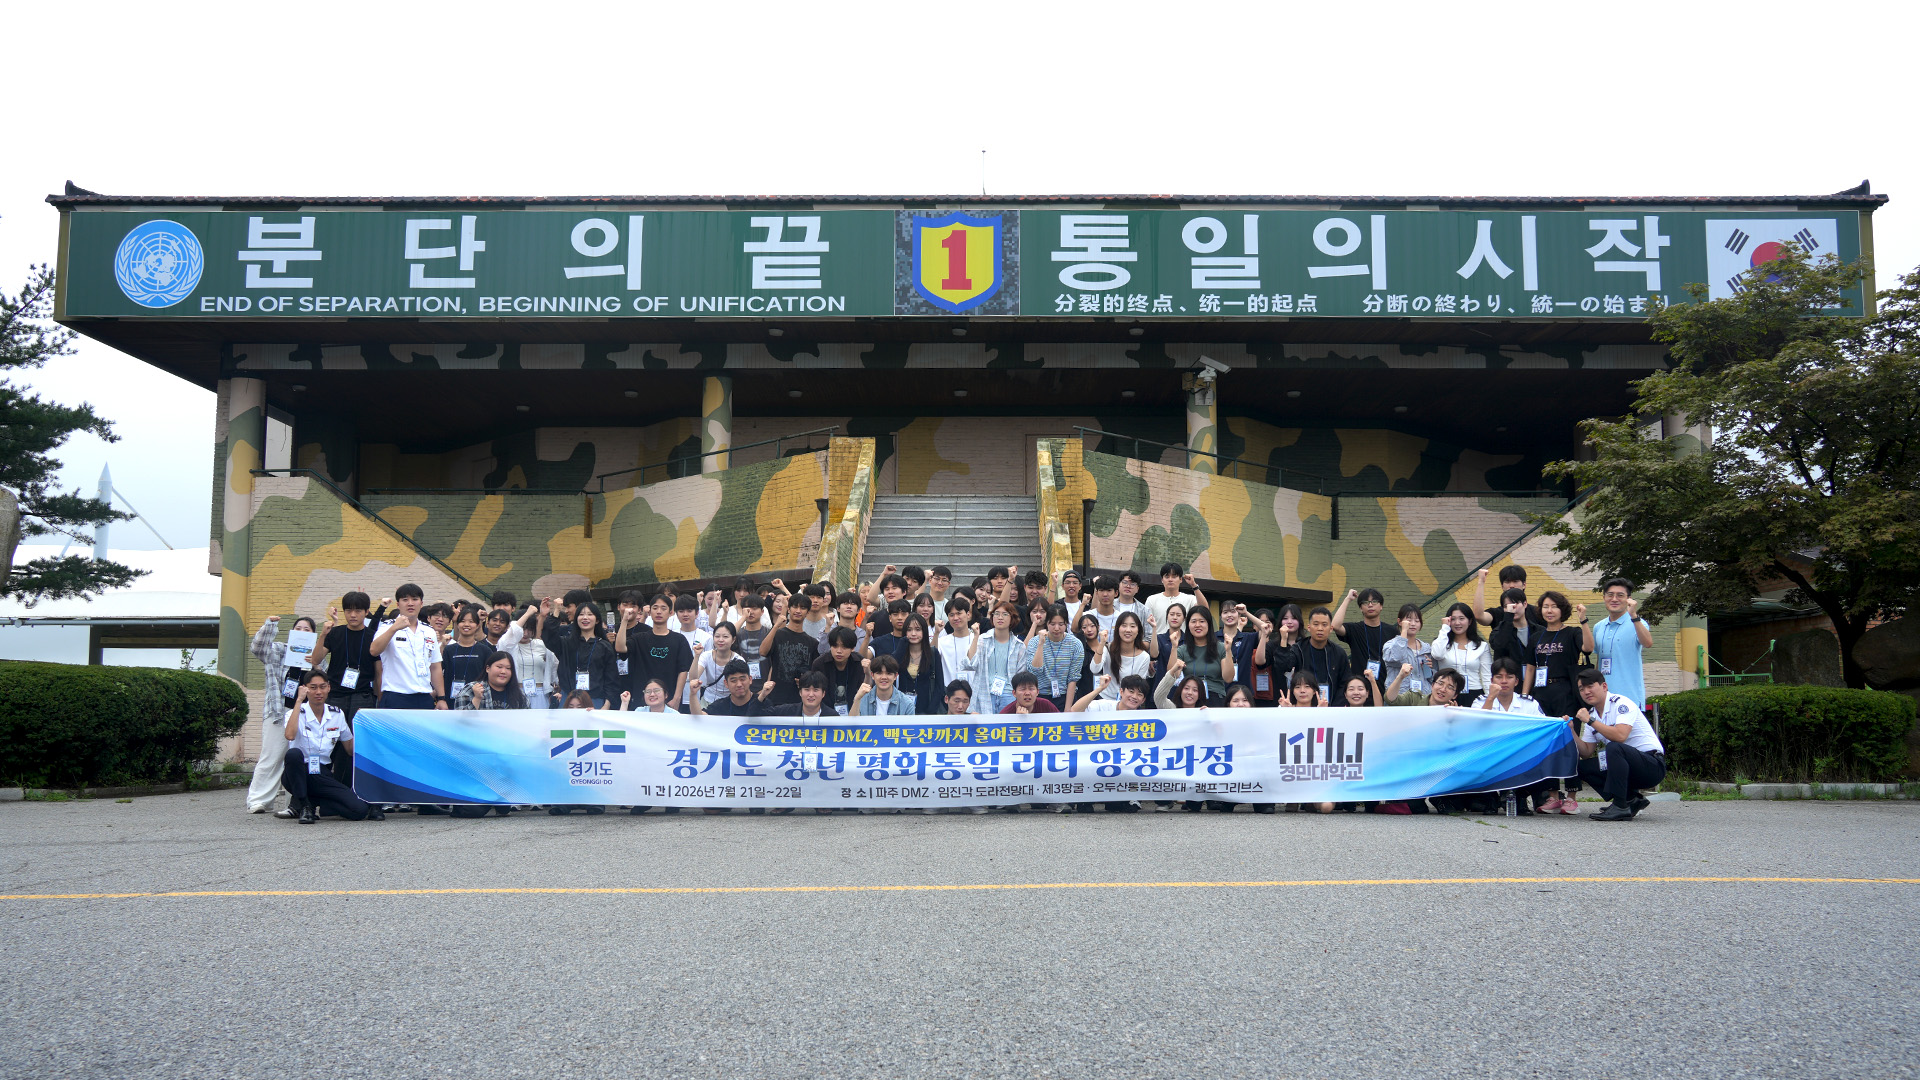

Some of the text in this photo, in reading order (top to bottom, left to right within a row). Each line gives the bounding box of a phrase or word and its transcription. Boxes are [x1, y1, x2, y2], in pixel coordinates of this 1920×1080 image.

[239, 216, 830, 290] 분단의 끝
[941, 229, 972, 290] 1
[1051, 215, 1671, 291] 통일의 시작
[201, 295, 845, 315] END OF SEPARATION, BEGINNING OF UNIFICATION
[1055, 293, 1318, 313] 分裂的终点、统一的起点
[744, 721, 1156, 746] 온라인부터 DMZ, 백두산까지 올여름 가장 특별한 경험
[569, 761, 613, 777] 경기도
[667, 748, 767, 780] 경기도
[775, 750, 846, 781] 청년
[856, 750, 1000, 781] 평화통일
[1012, 749, 1078, 779] 리더
[1089, 744, 1233, 778] 양성과정
[1280, 763, 1364, 782] 경민대학교
[674, 785, 715, 798] 2026년
[718, 786, 736, 798] 7월
[875, 787, 899, 799] 파주
[901, 787, 930, 798] DMZ
[937, 786, 974, 799] 임진각
[975, 784, 1035, 797] 도라전망대
[1042, 782, 1084, 795] 제3땅굴
[1092, 782, 1186, 793] 오두산통일전망대
[1195, 782, 1263, 794] 캠프그리브스
